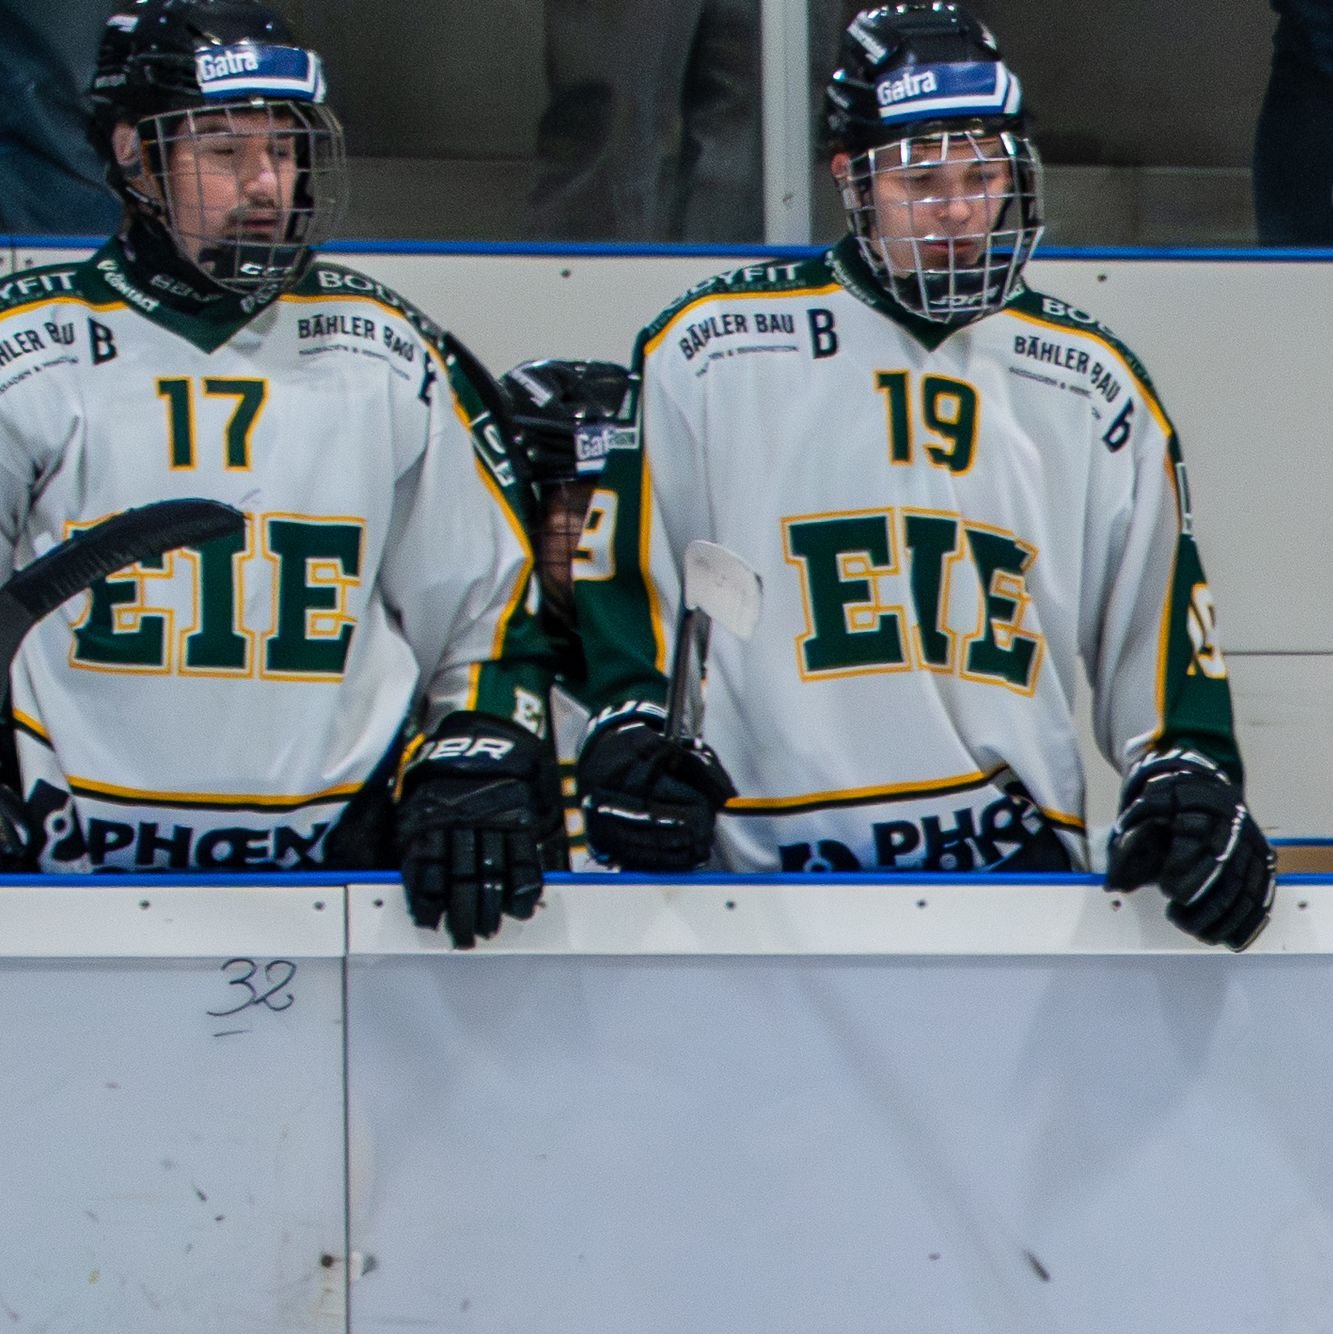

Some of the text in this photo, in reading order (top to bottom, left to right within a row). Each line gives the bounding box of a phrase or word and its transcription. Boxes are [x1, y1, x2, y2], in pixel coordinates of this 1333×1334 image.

[200, 50, 258, 81] Gatra
[877, 70, 938, 106] Gatra
[754, 313, 795, 335] BAU
[807, 308, 838, 360] B
[153, 375, 269, 473] 17
[873, 368, 980, 476] 19
[63, 510, 367, 683] EIE
[780, 506, 1040, 698] EIE
[206, 957, 297, 1018] 32
